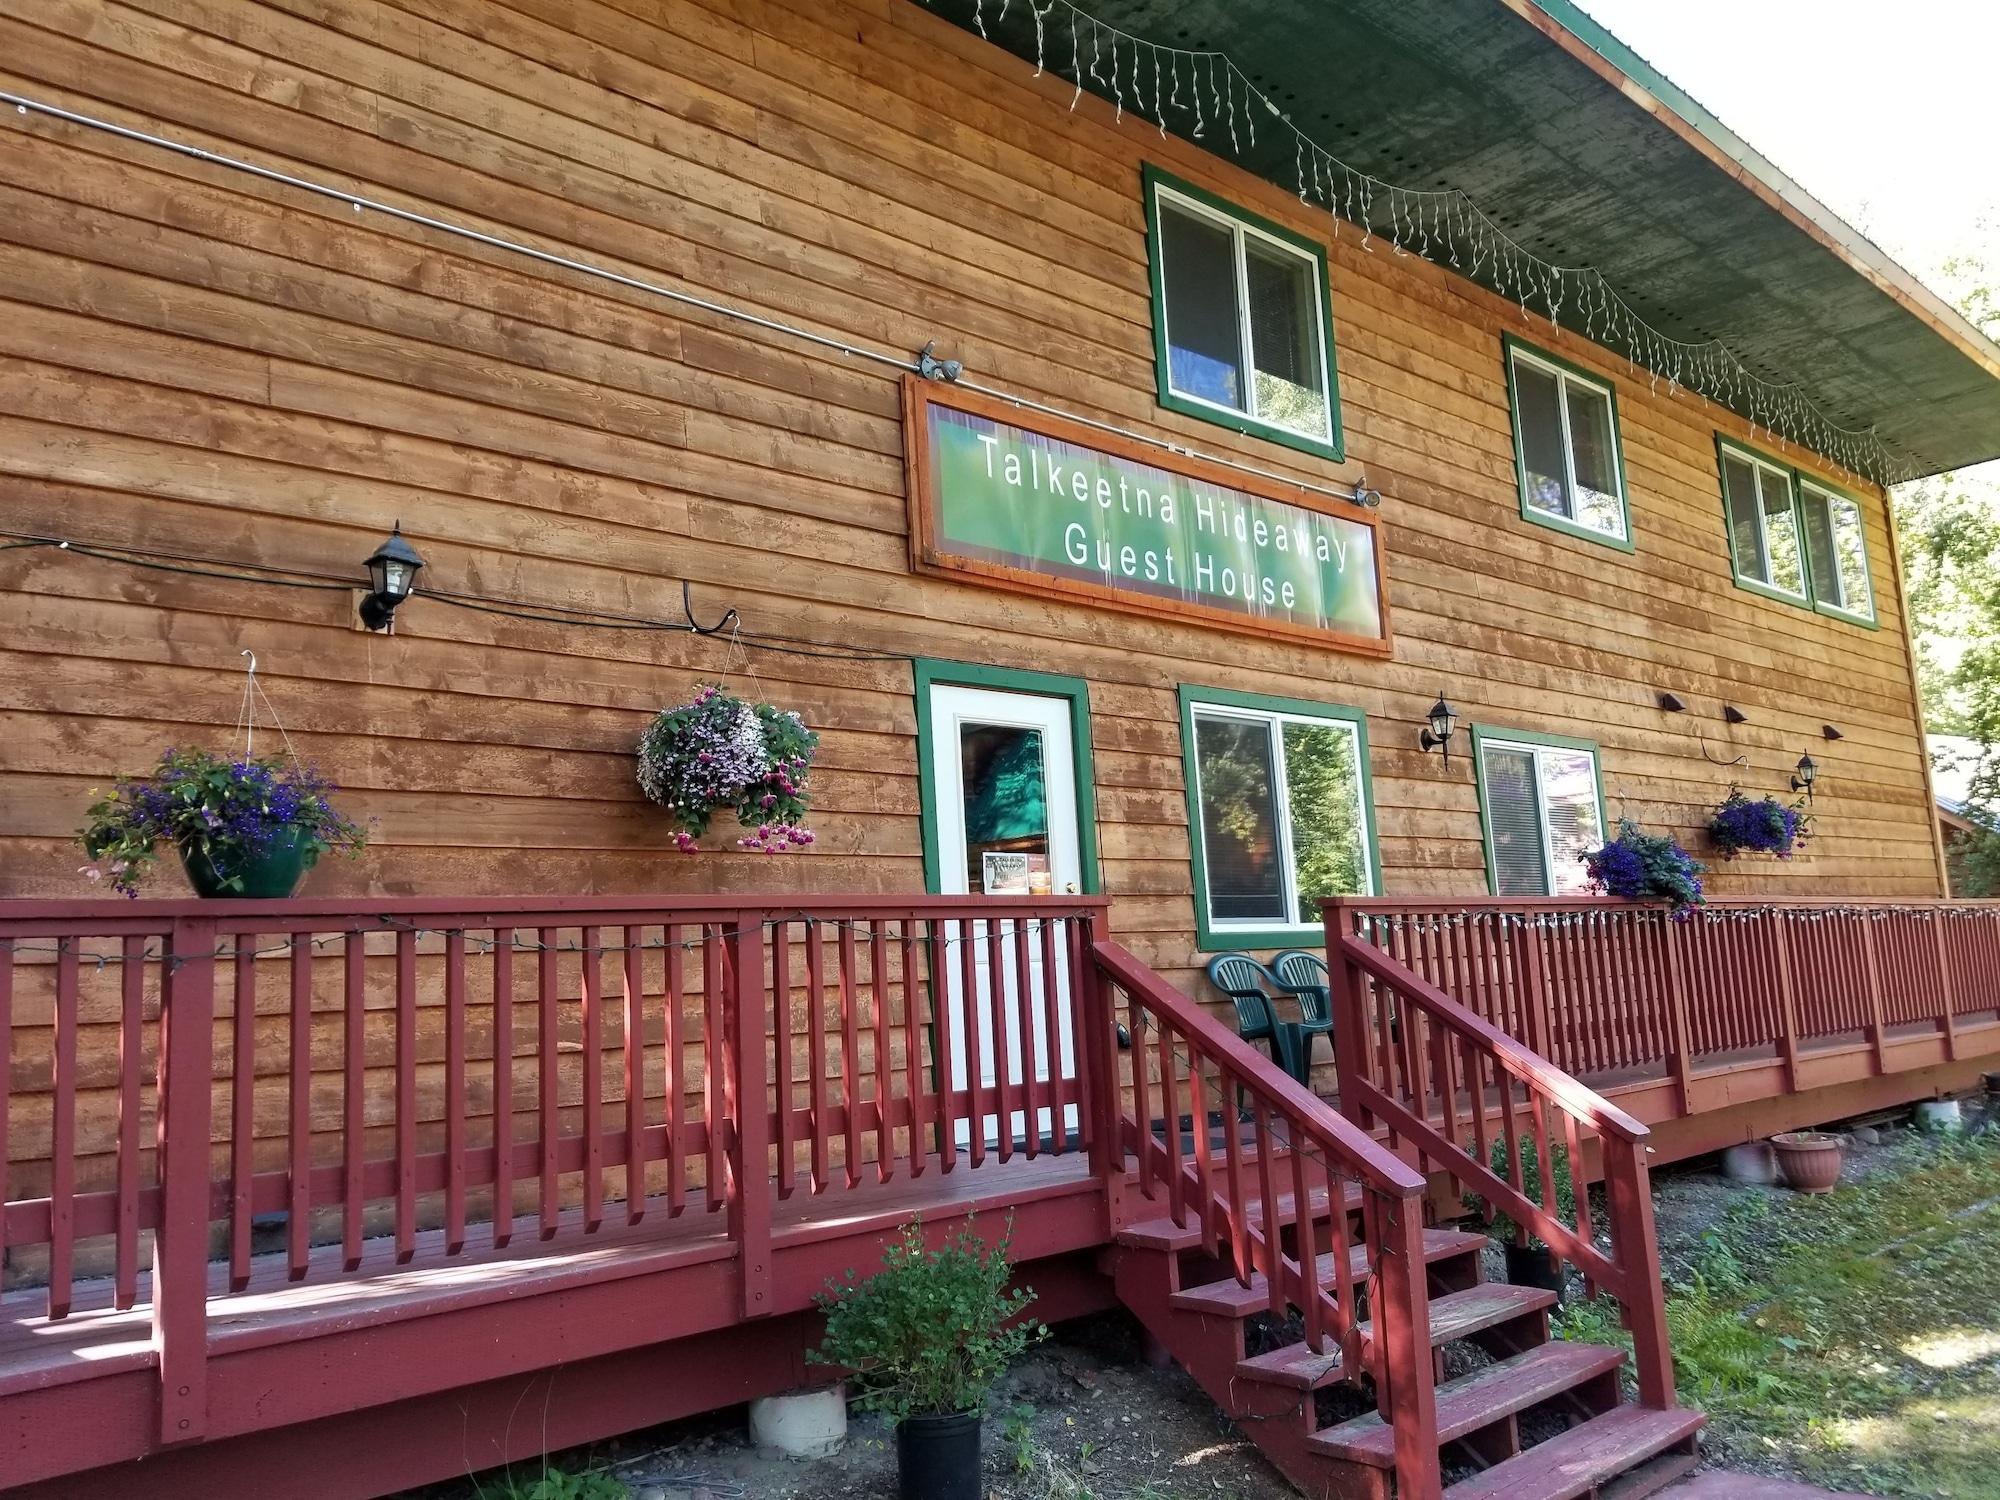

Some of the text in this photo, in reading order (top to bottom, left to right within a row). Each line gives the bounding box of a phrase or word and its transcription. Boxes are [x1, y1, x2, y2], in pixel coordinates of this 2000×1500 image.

[977, 434, 1347, 574] Talkeetna Hideaway
[1064, 522, 1295, 609] Guest House
